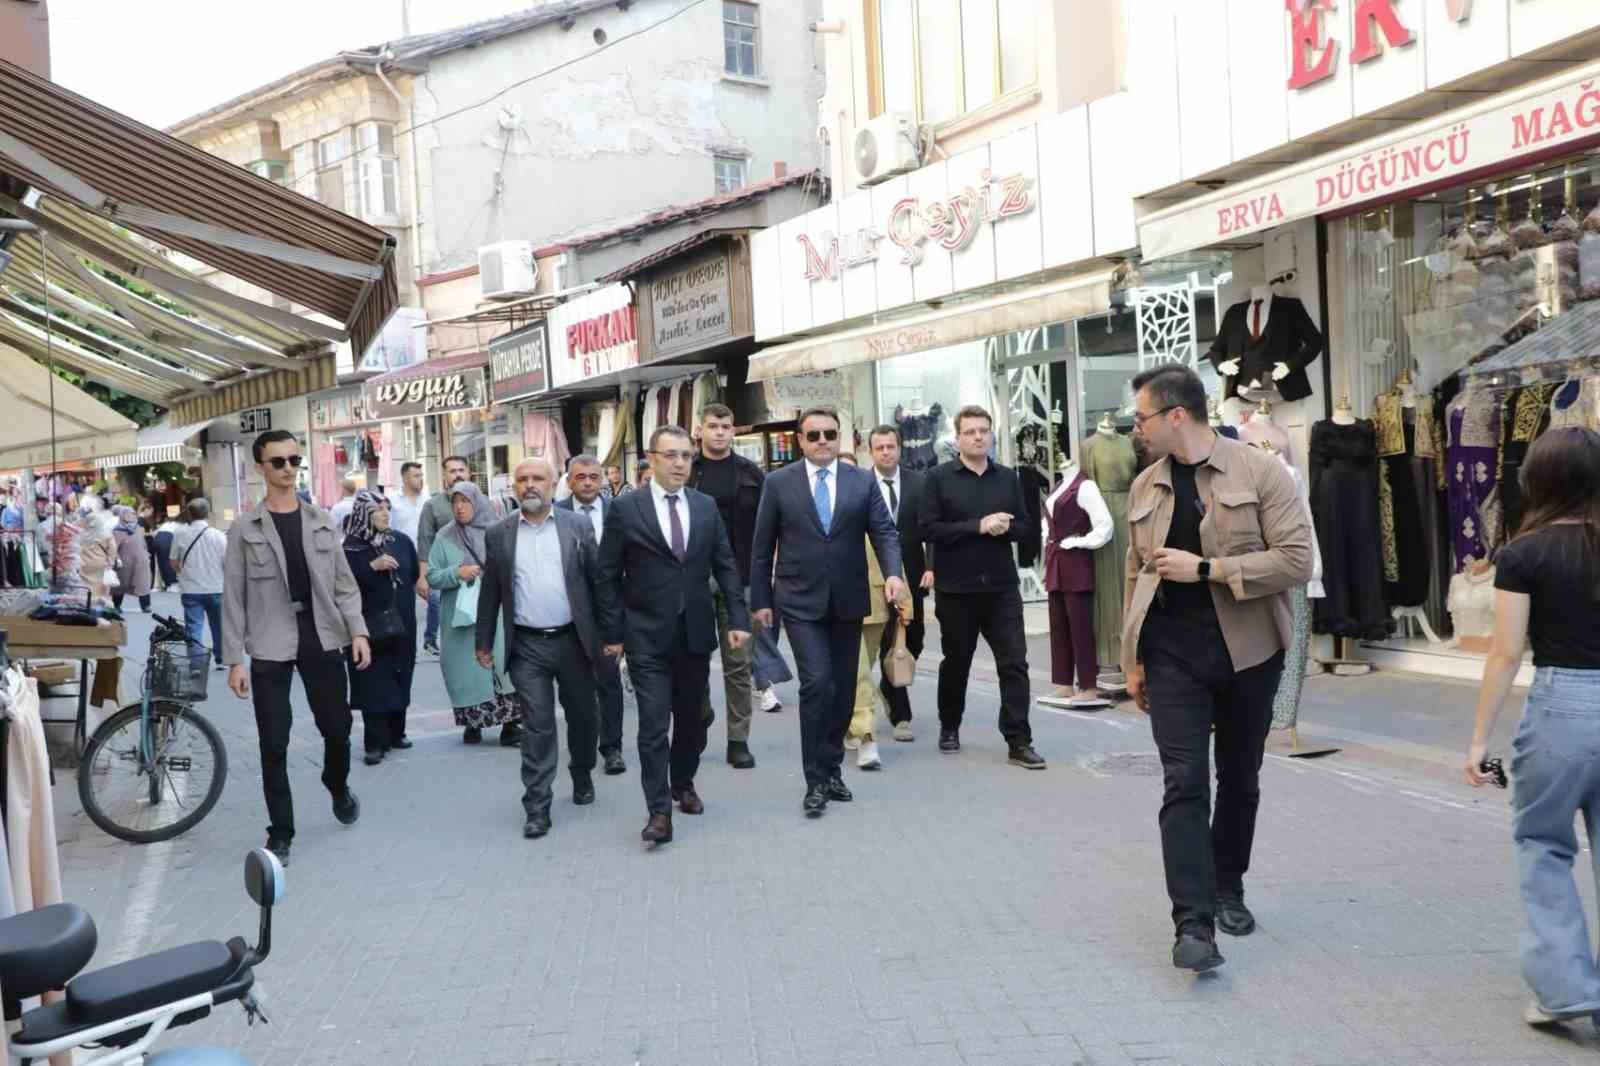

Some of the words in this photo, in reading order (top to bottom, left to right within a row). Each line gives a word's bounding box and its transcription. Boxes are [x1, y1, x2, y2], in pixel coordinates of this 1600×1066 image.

[1217, 193, 1285, 236] ERVA
[1315, 123, 1471, 208] DÜĞÜNCÜ
[887, 168, 1036, 267] Çeyiz
[566, 304, 637, 360] FURKAN
[375, 373, 464, 405] uygun
[424, 391, 465, 411] perde
